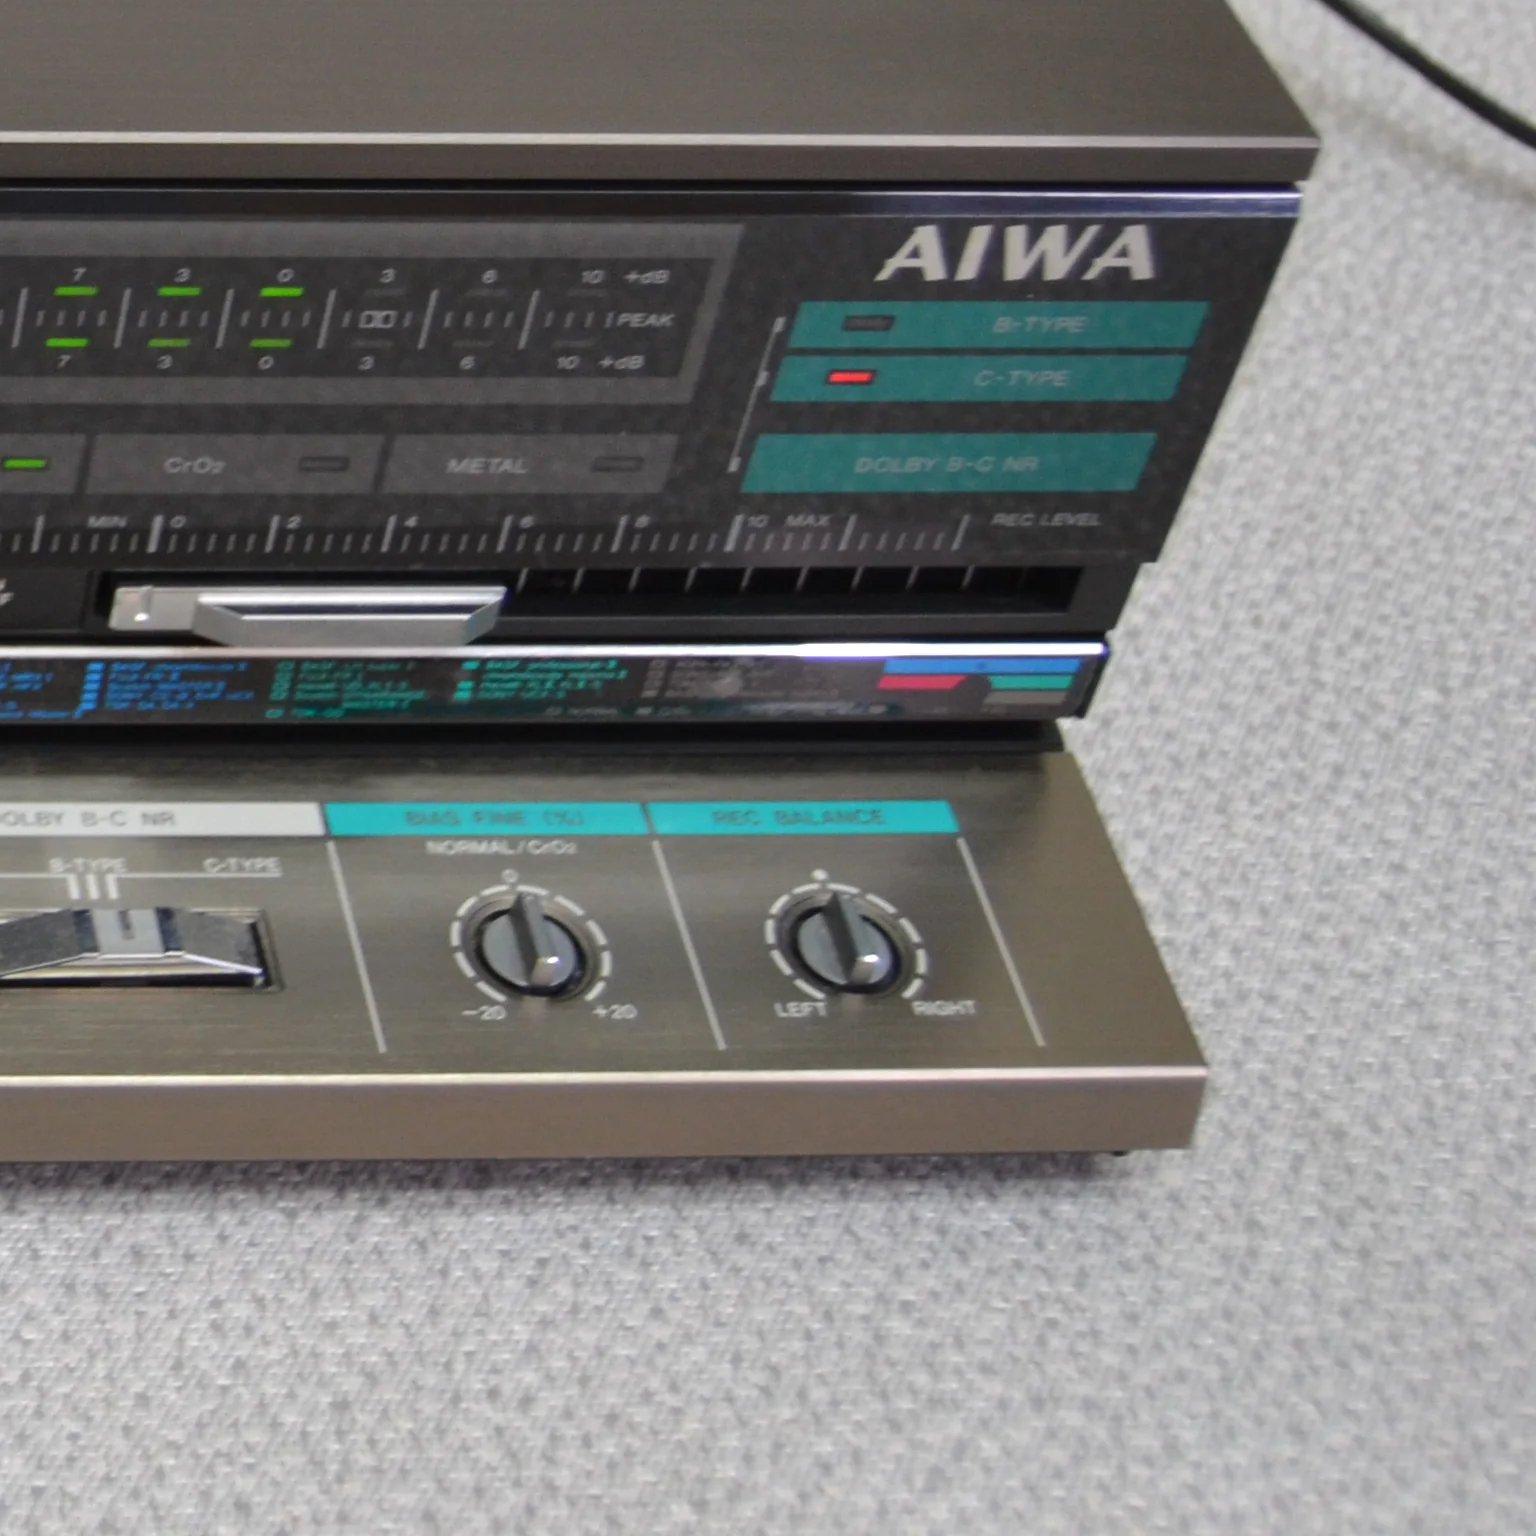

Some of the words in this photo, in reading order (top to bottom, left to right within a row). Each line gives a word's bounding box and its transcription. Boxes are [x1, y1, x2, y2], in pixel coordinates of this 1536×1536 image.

[873, 223, 1157, 283] AIWA
[581, 270, 605, 284] 10
[616, 311, 676, 329] PEAK
[557, 356, 580, 370] 10
[972, 368, 1073, 388] C-TYPE
[444, 456, 534, 476] METAL
[853, 456, 939, 475] DOLBY
[785, 514, 835, 529] MAX
[139, 810, 179, 827] NR
[404, 810, 462, 827] BIAS
[472, 810, 528, 827] FINE
[711, 809, 763, 827] REC
[772, 809, 888, 827] BALANCE
[48, 857, 128, 874] B-TYPE
[202, 857, 283, 874] C-TYPE
[772, 999, 829, 1019] LEFT
[909, 999, 980, 1017] RIGHT
